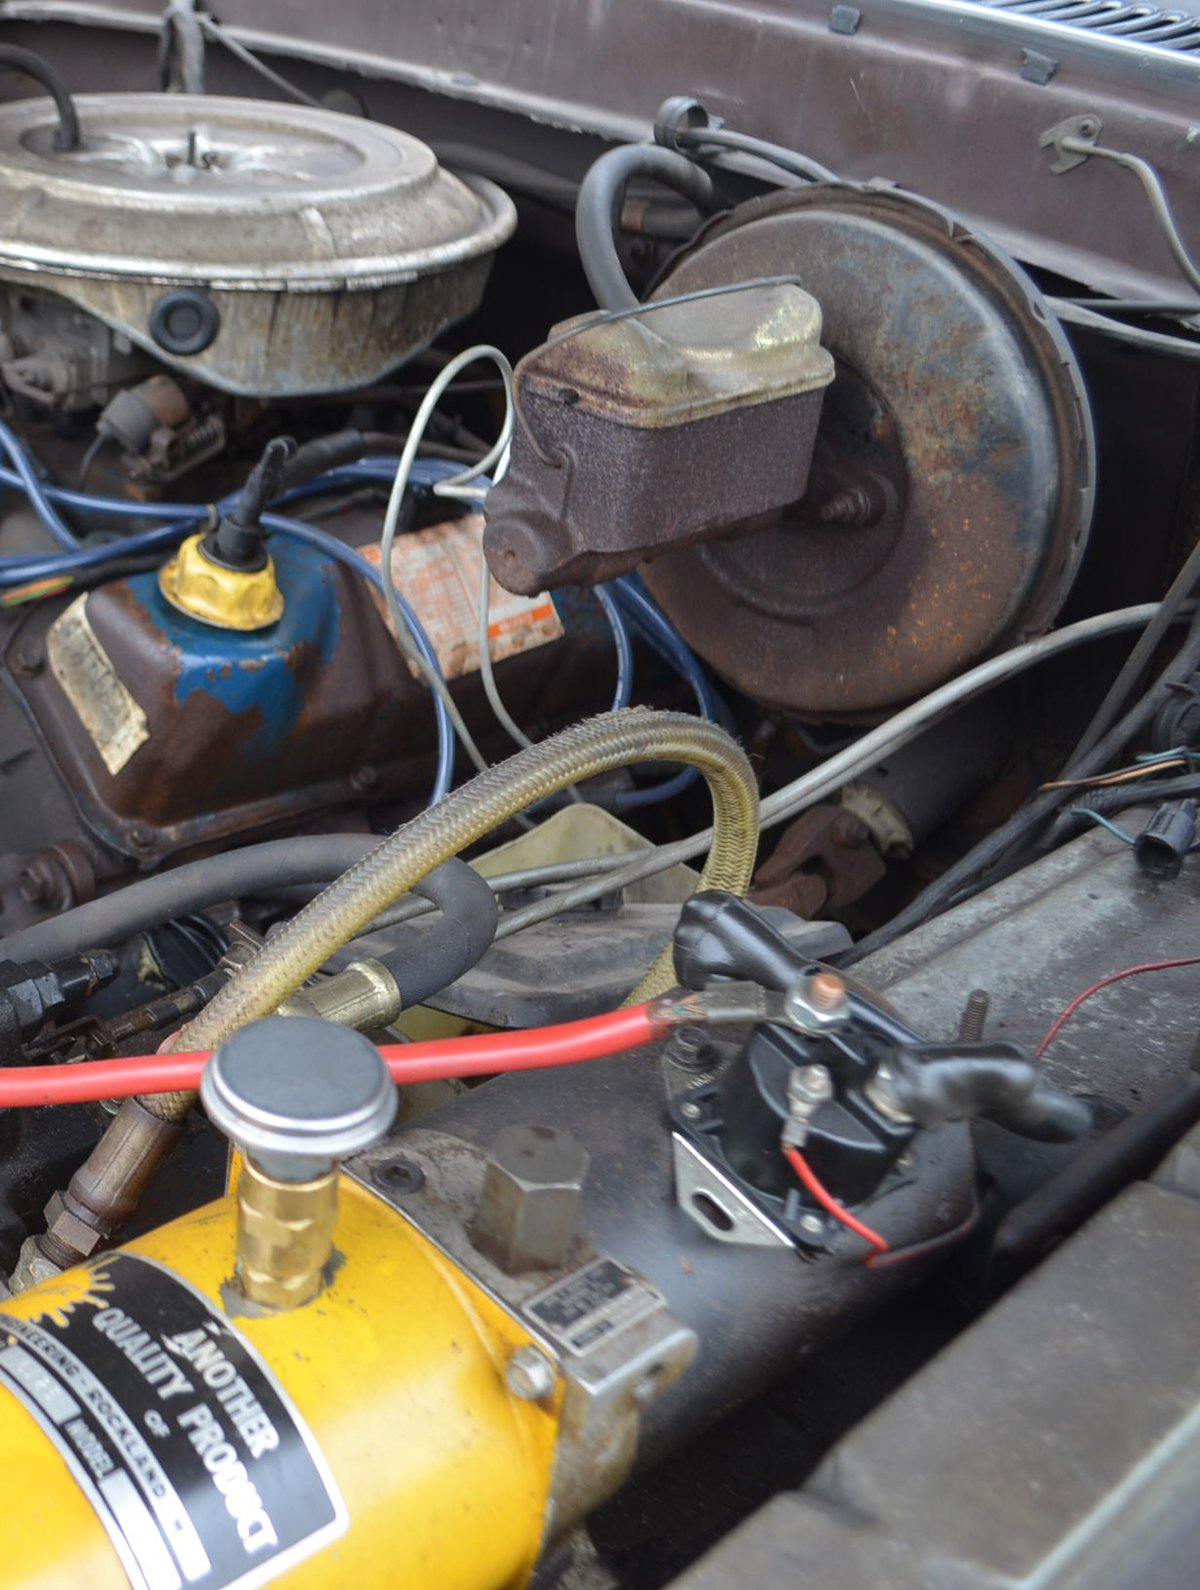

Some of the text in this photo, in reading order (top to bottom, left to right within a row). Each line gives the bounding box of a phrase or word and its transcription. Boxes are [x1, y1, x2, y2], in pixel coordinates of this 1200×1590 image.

[92, 1307, 280, 1554] QUALITY PRODUCT
[143, 1408, 171, 1439] OF
[172, 1328, 281, 1460] ANOTHER
[64, 1417, 116, 1481] MODEL
